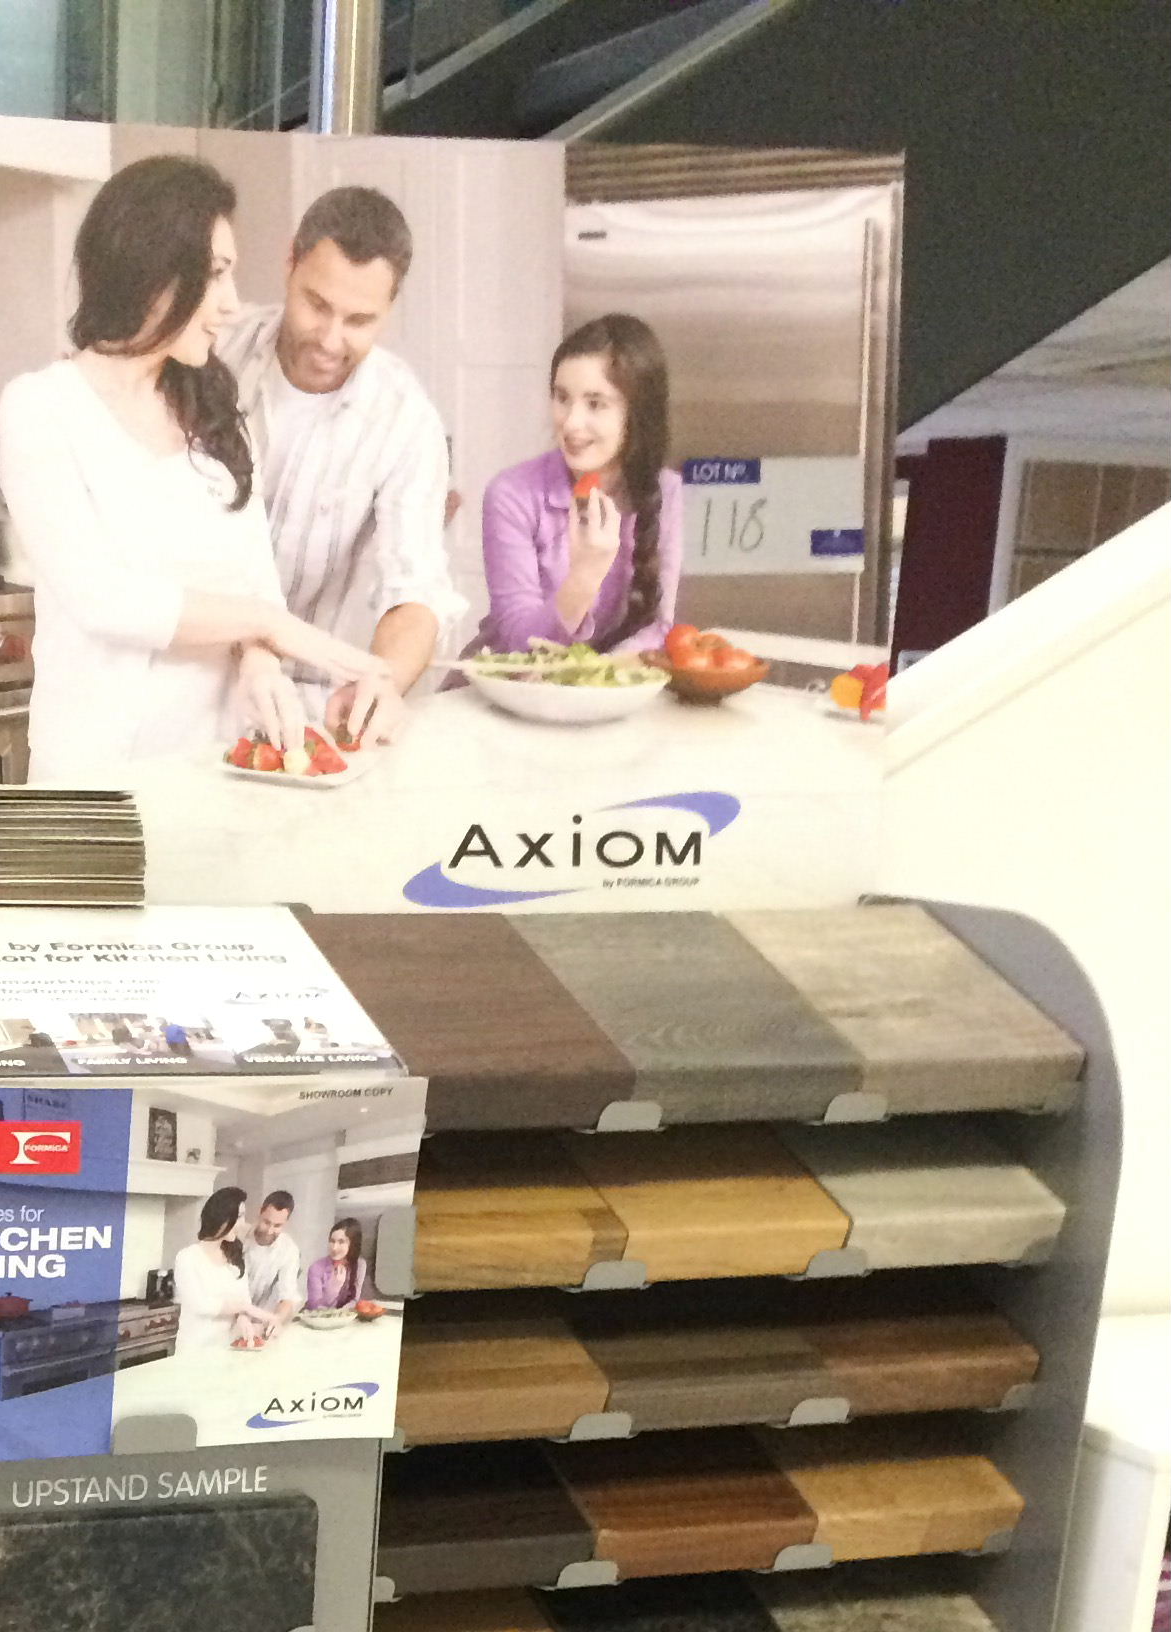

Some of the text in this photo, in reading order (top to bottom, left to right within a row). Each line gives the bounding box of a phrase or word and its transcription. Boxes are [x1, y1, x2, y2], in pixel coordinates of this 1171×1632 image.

[692, 462, 720, 482] LOT
[701, 498, 768, 557] 118
[8, 941, 40, 953] by
[49, 941, 163, 952] Formica
[170, 941, 255, 952] Group
[45, 953, 82, 963] for
[94, 953, 200, 963] Kitchen
[206, 953, 288, 965] Living
[298, 1087, 394, 1100] SHOWROOM COPY
[19, 1204, 45, 1222] for
[11, 1465, 268, 1508] UPSTAND SAMPLE
